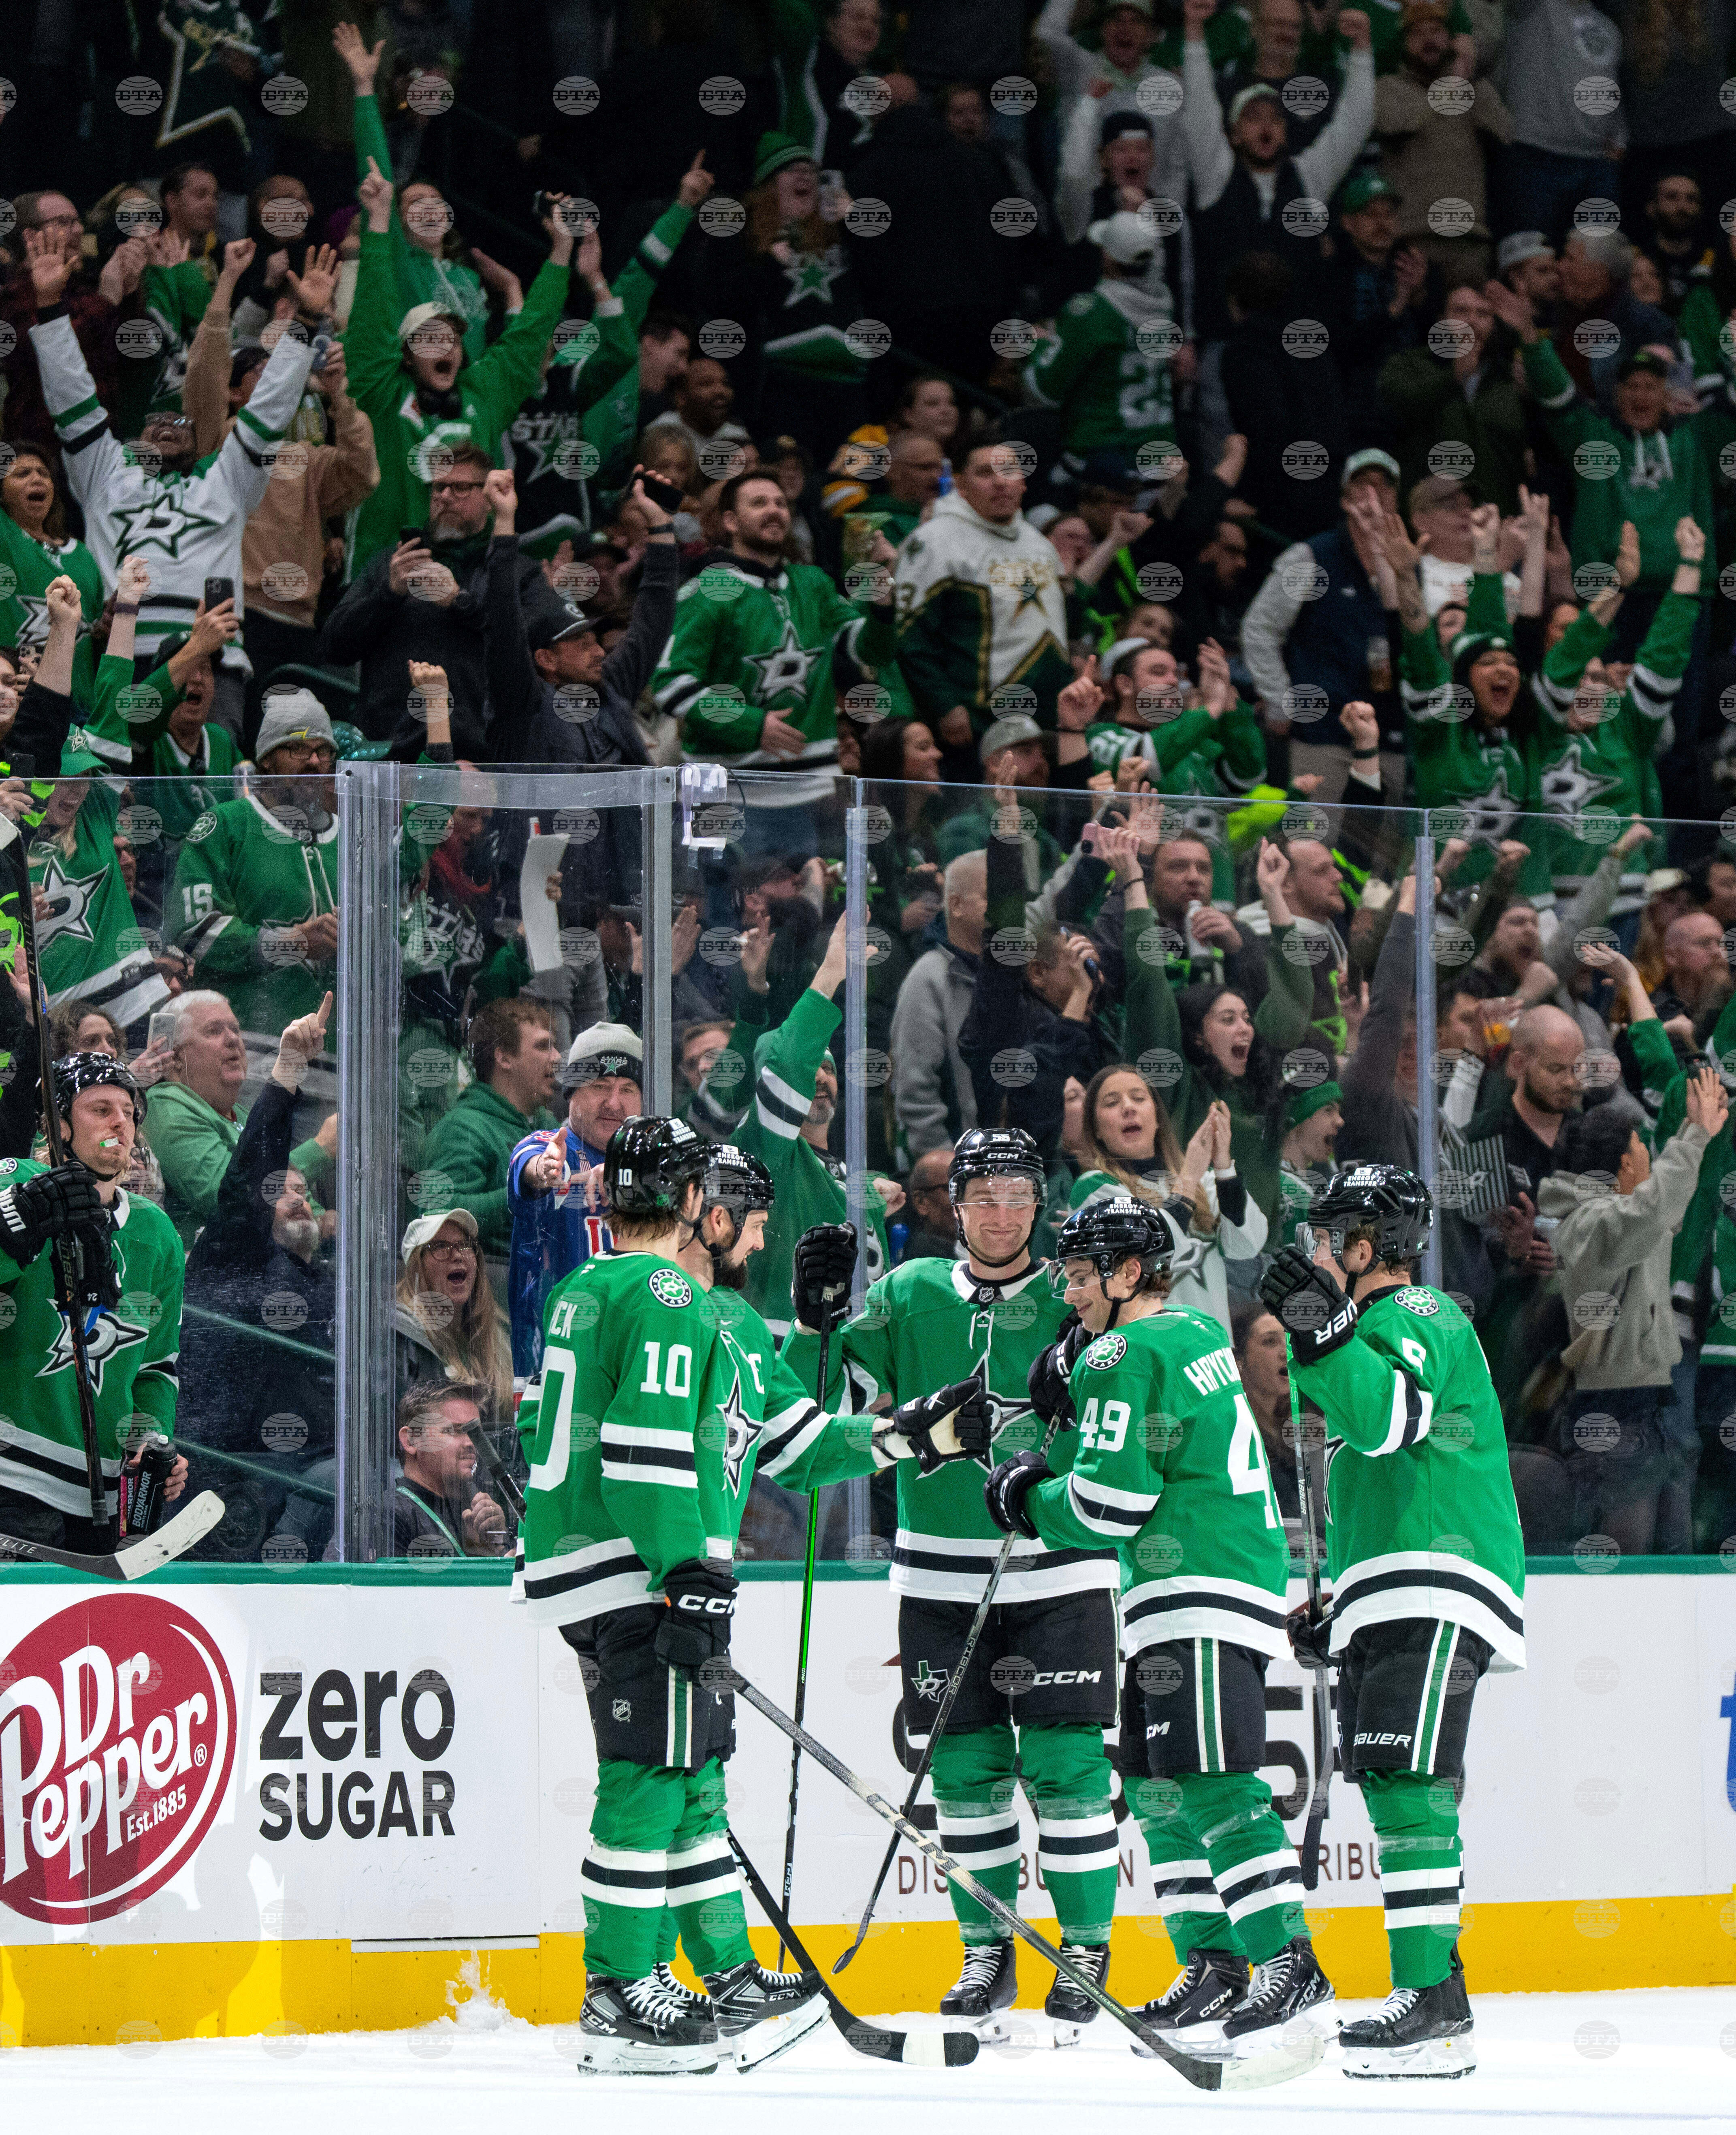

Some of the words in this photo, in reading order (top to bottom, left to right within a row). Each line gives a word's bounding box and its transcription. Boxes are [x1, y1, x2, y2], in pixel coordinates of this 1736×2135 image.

[182, 883, 213, 924] 15
[717, 1152, 744, 1161] ENERGY
[618, 1169, 633, 1186] 10
[548, 1296, 578, 1339] CK
[640, 1341, 692, 1398] 10
[748, 1353, 765, 1394] C
[1079, 1397, 1131, 1452] 49
[132, 1471, 151, 1528] BODYARMOR
[1299, 1485, 1307, 1514] BAUER
[1033, 1671, 1102, 1685] CCM
[60, 1644, 150, 1768] Dr
[259, 1669, 455, 1762] zero
[1353, 1733, 1412, 1749] BAUER
[1, 1675, 208, 1885] Pepper
[126, 1784, 187, 1842] Est.1885
[259, 1771, 455, 1841] SUGAR
[769, 1992, 794, 2001] CCM
[1199, 1988, 1233, 2018] CCM
[581, 2003, 618, 2034] CCM
